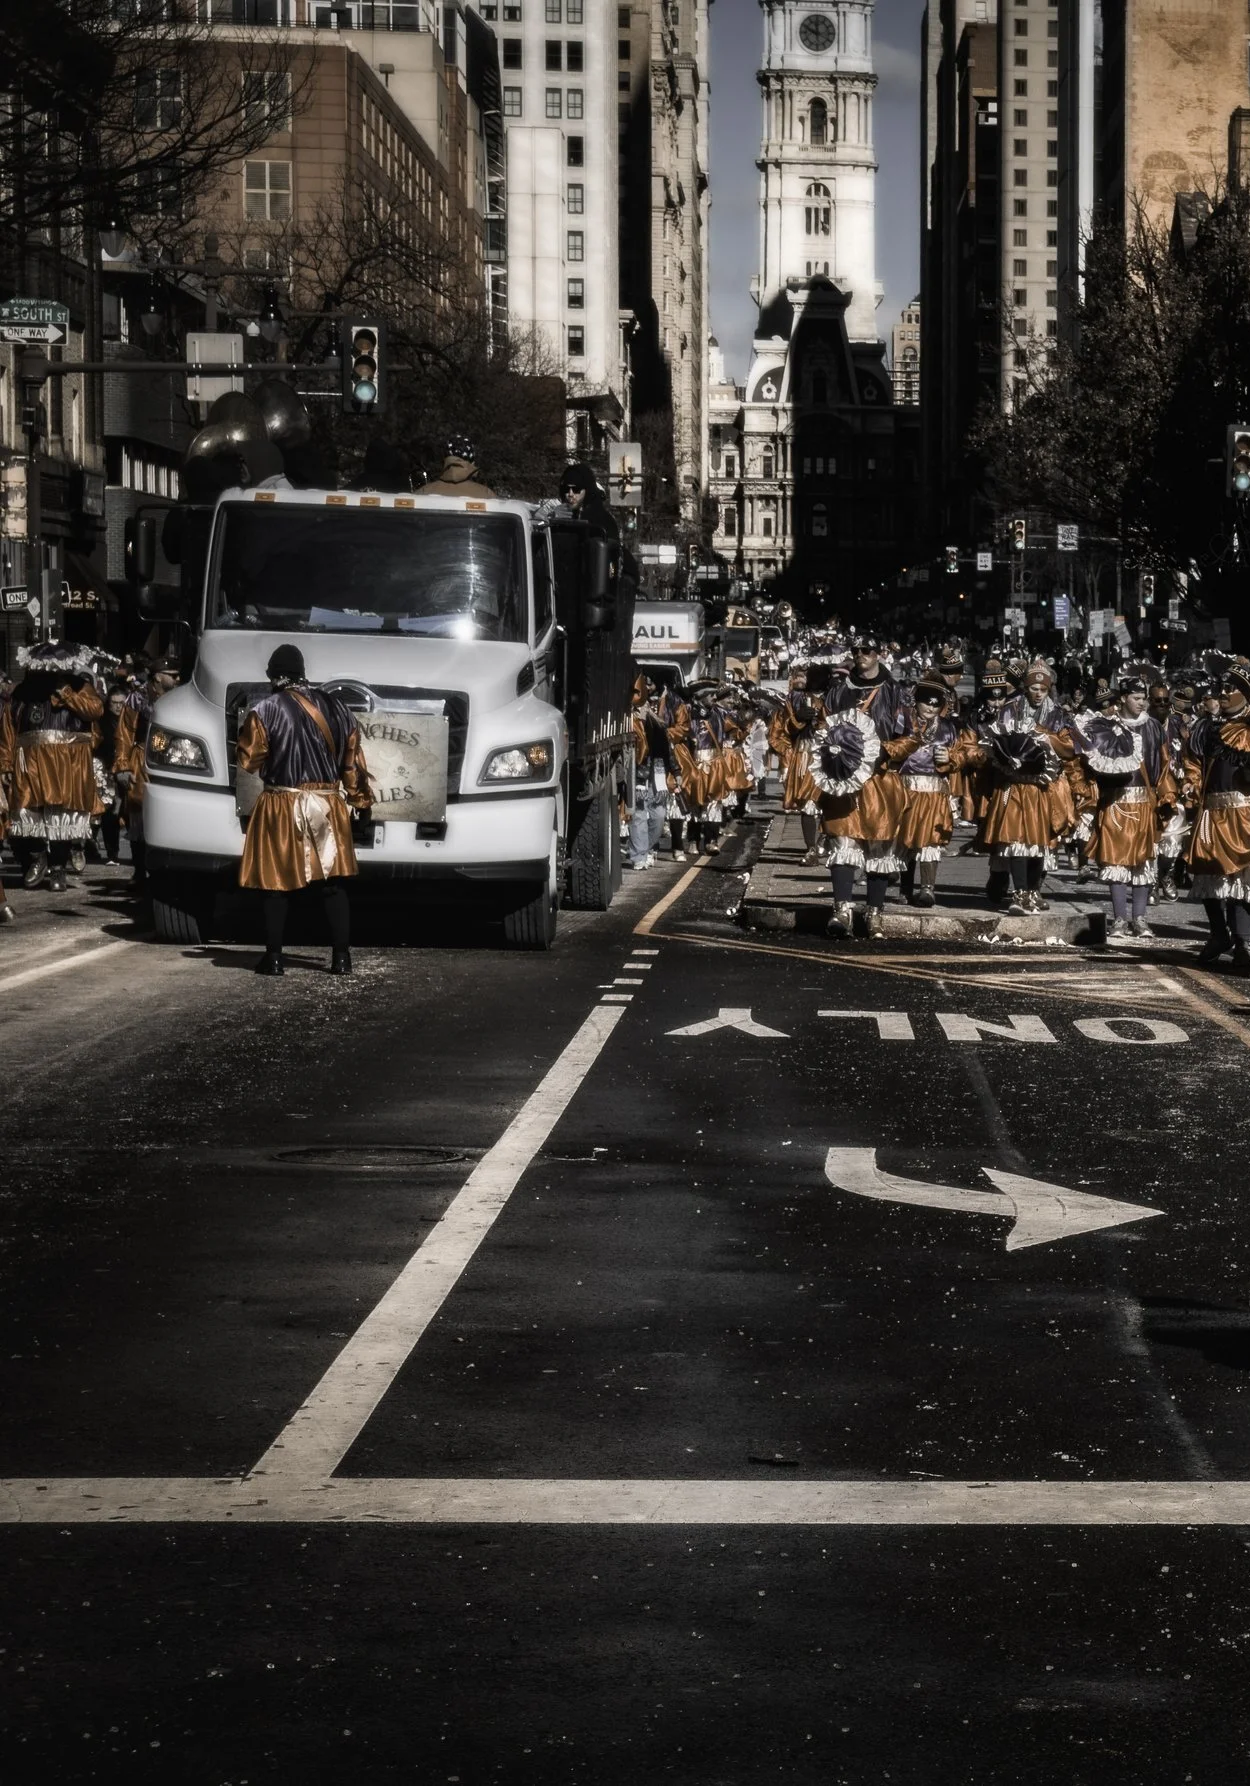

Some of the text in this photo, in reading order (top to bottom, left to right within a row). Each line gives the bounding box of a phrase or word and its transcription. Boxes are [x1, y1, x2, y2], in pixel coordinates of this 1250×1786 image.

[13, 307, 67, 321] SOUTH ST
[7, 327, 48, 337] ONE WAY
[8, 592, 27, 603] ONE
[663, 1007, 1190, 1045] ONLY
